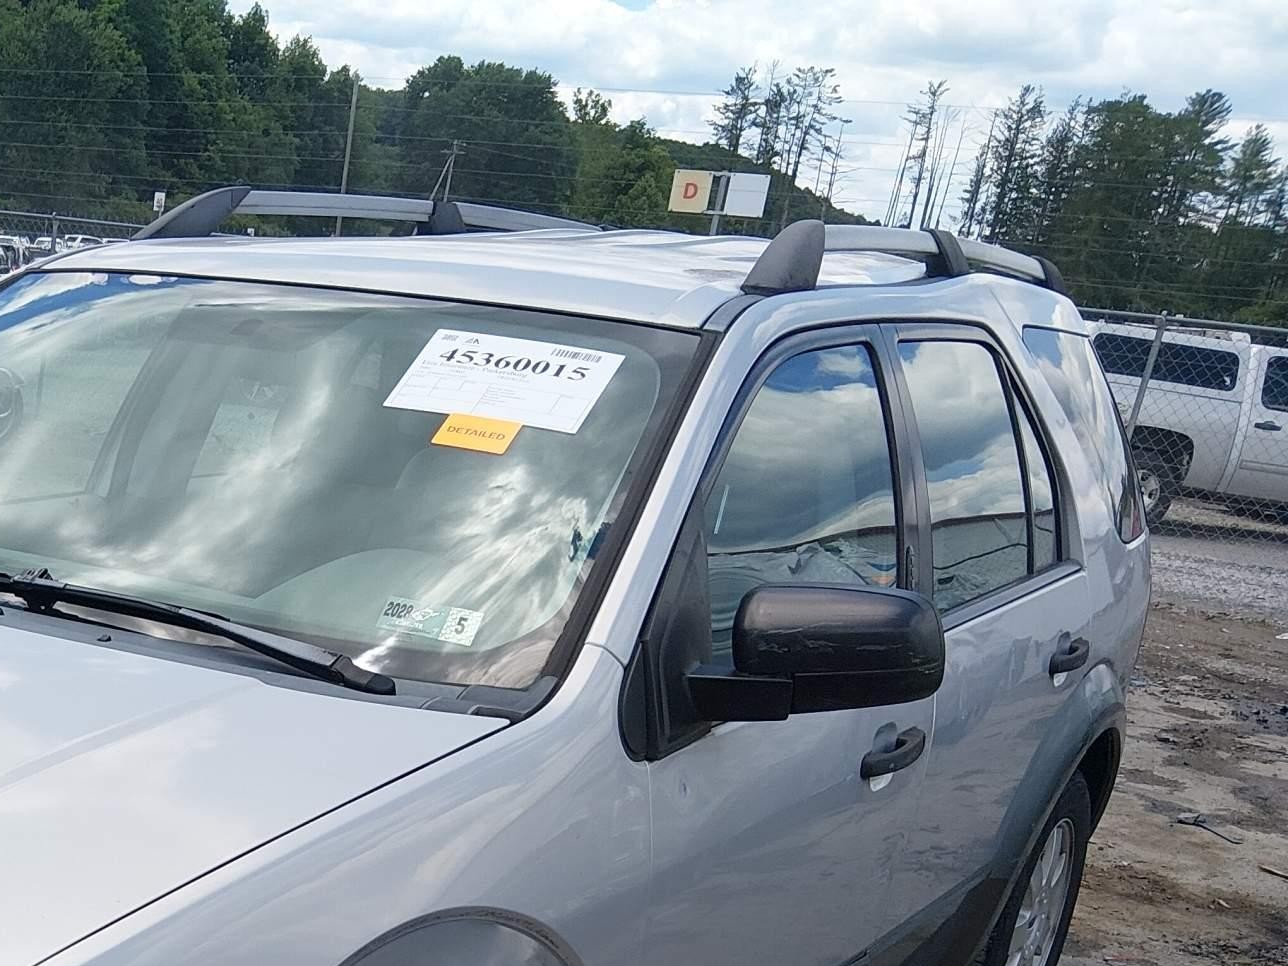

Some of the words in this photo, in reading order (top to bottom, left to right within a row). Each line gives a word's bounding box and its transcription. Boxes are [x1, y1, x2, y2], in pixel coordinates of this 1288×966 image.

[682, 182, 698, 200] D
[439, 347, 591, 381] 45360015
[446, 424, 506, 441] DETAILED
[454, 616, 469, 635] 5
